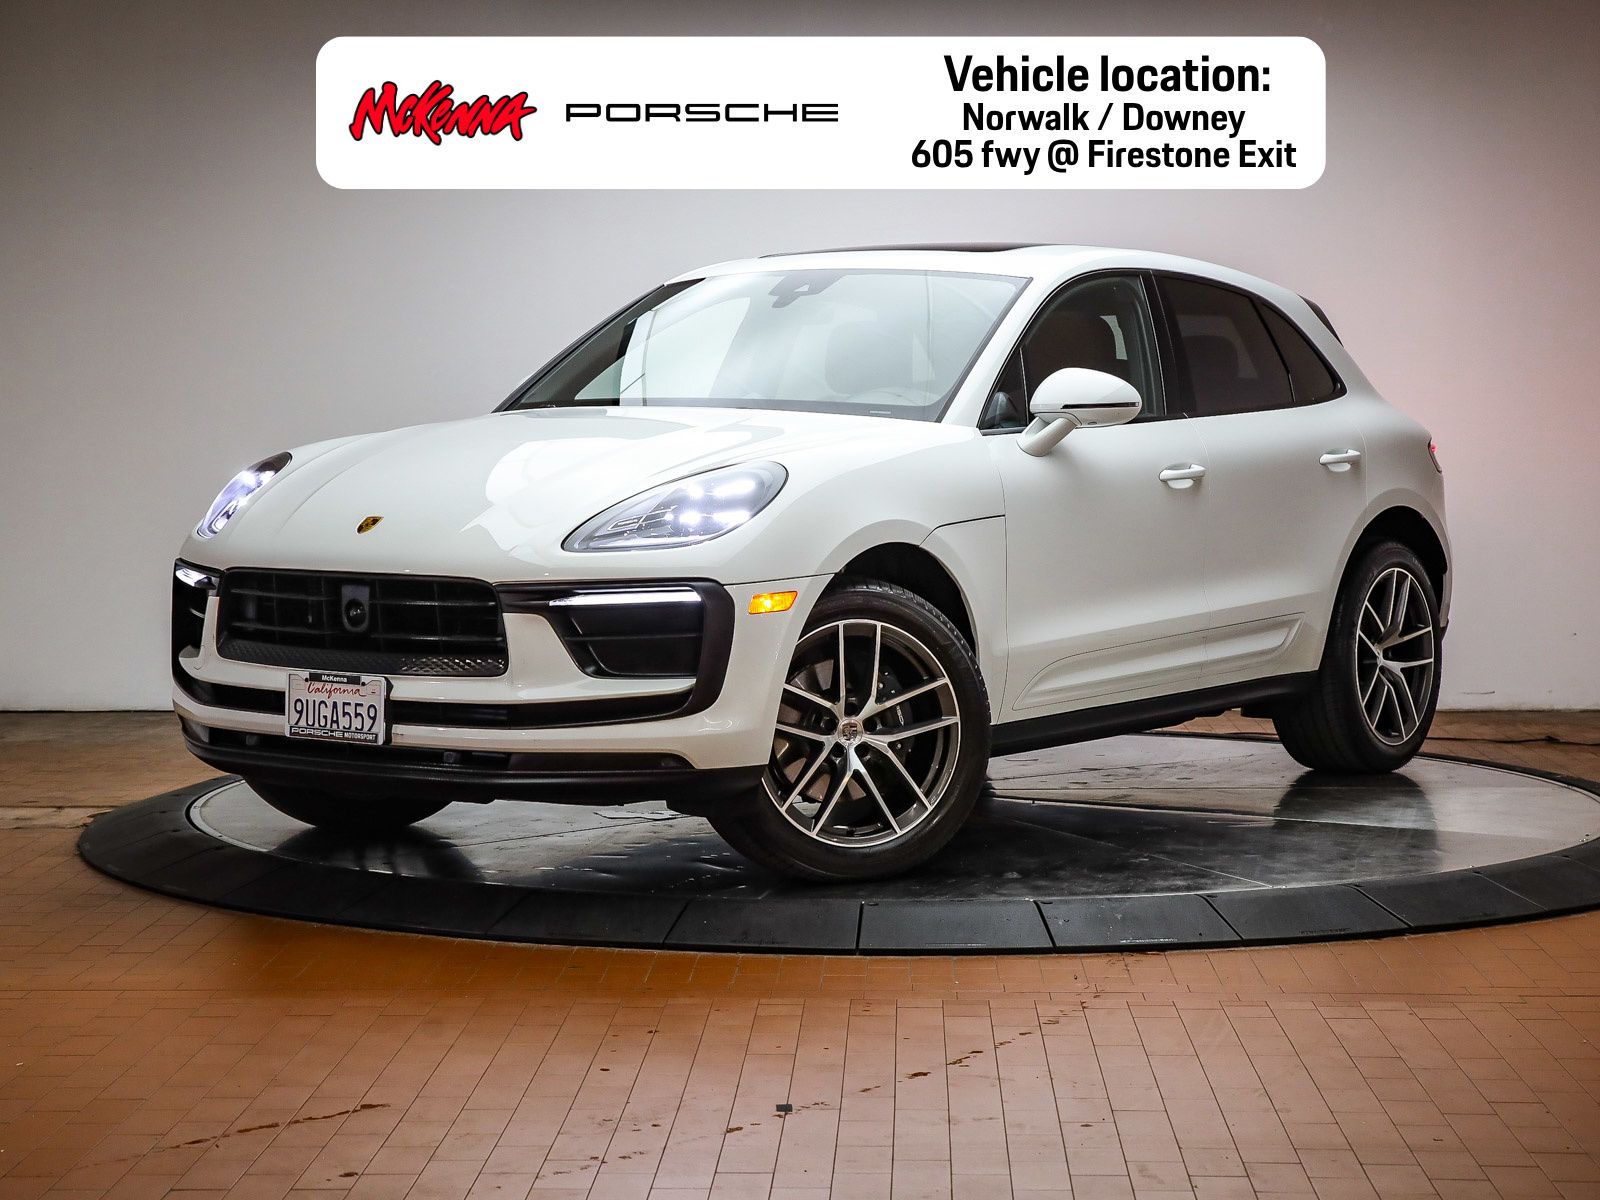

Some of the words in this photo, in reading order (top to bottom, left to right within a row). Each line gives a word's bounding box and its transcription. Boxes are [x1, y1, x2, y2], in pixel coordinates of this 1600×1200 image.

[321, 674, 348, 683] McKenna
[307, 682, 367, 699] California
[294, 698, 378, 732] 9UGA559
[291, 728, 343, 738] PORSCHE
[344, 731, 376, 741] MOTORSPORT
